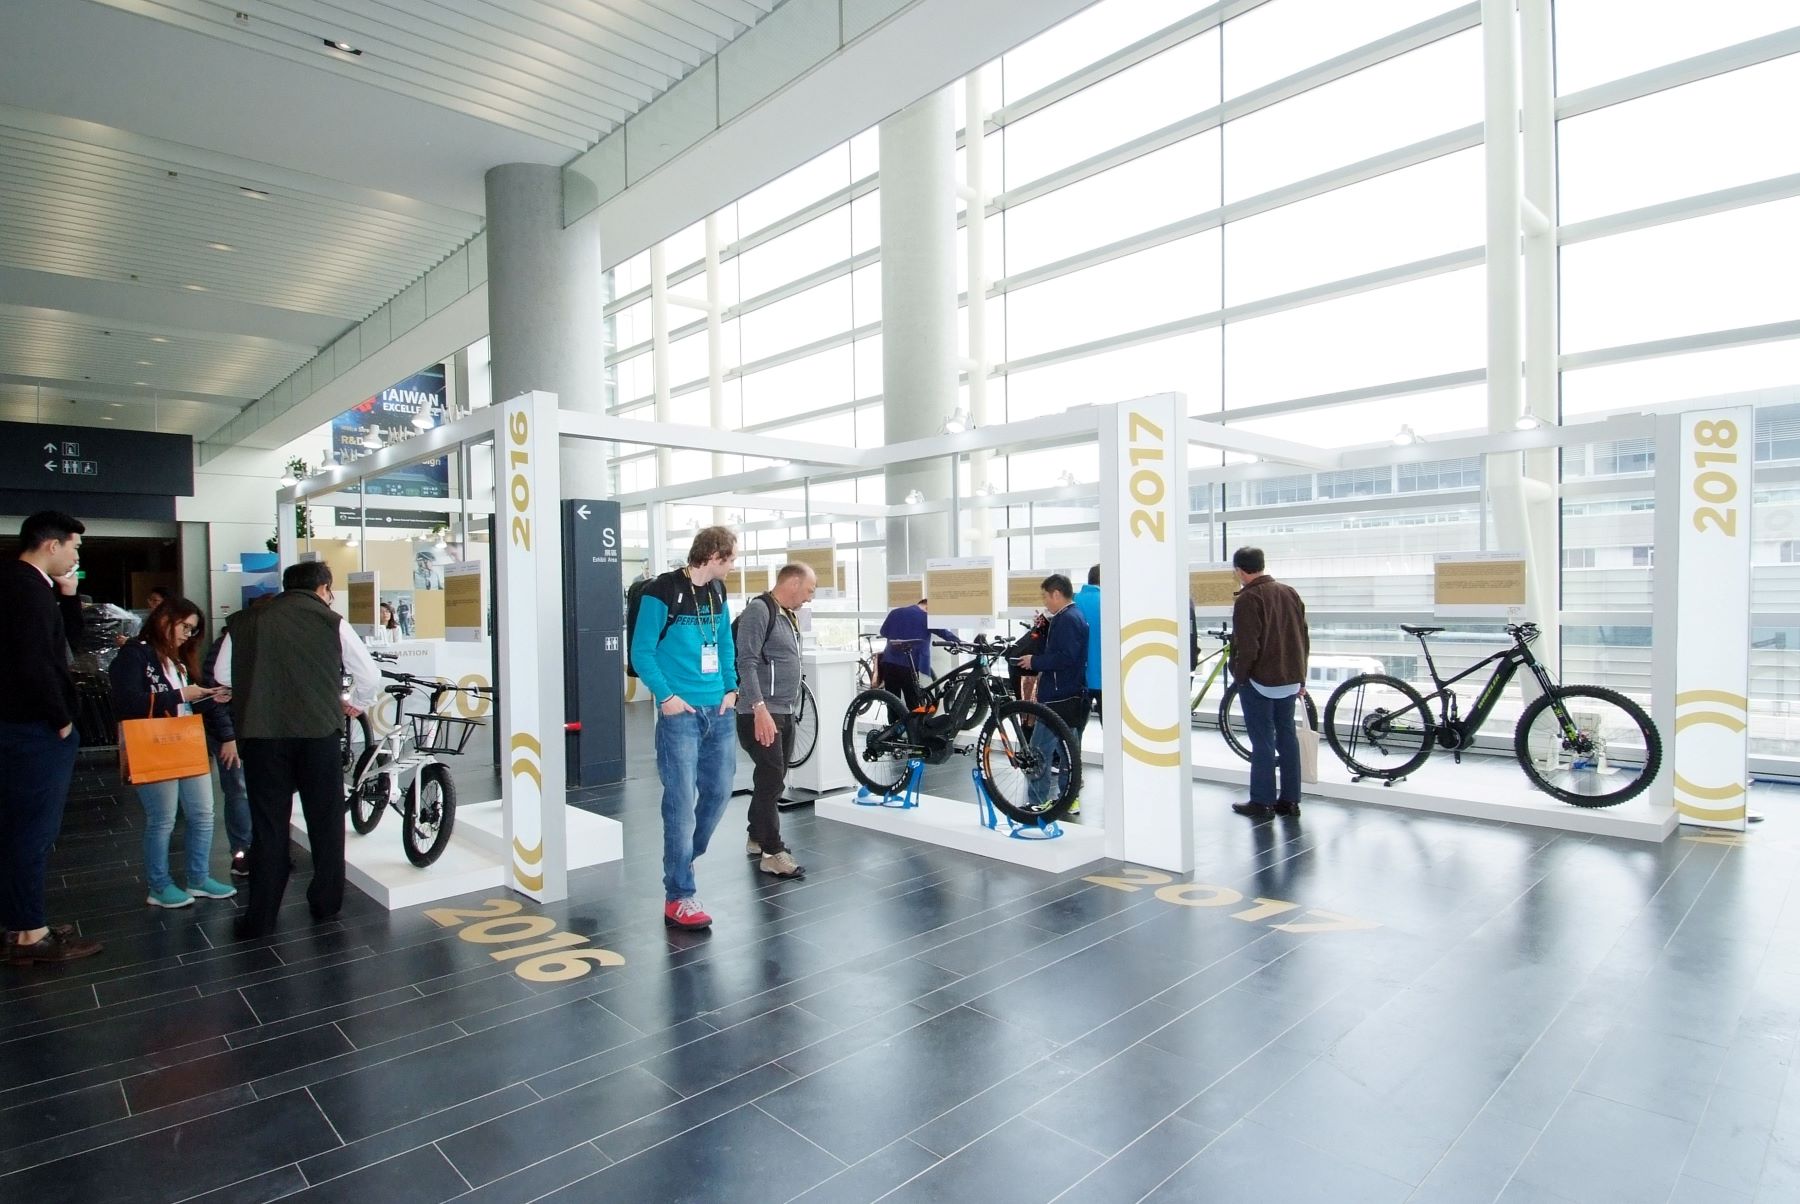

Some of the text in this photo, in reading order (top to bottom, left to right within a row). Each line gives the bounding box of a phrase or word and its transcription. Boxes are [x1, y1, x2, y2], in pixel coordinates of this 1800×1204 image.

[383, 388, 439, 407] TAIWAN
[509, 411, 531, 552] 2016
[1129, 411, 1165, 543] 2017
[1693, 419, 1739, 538] 2018
[602, 527, 615, 548] S
[422, 898, 626, 983] 2016
[1081, 868, 1385, 934] 2017
